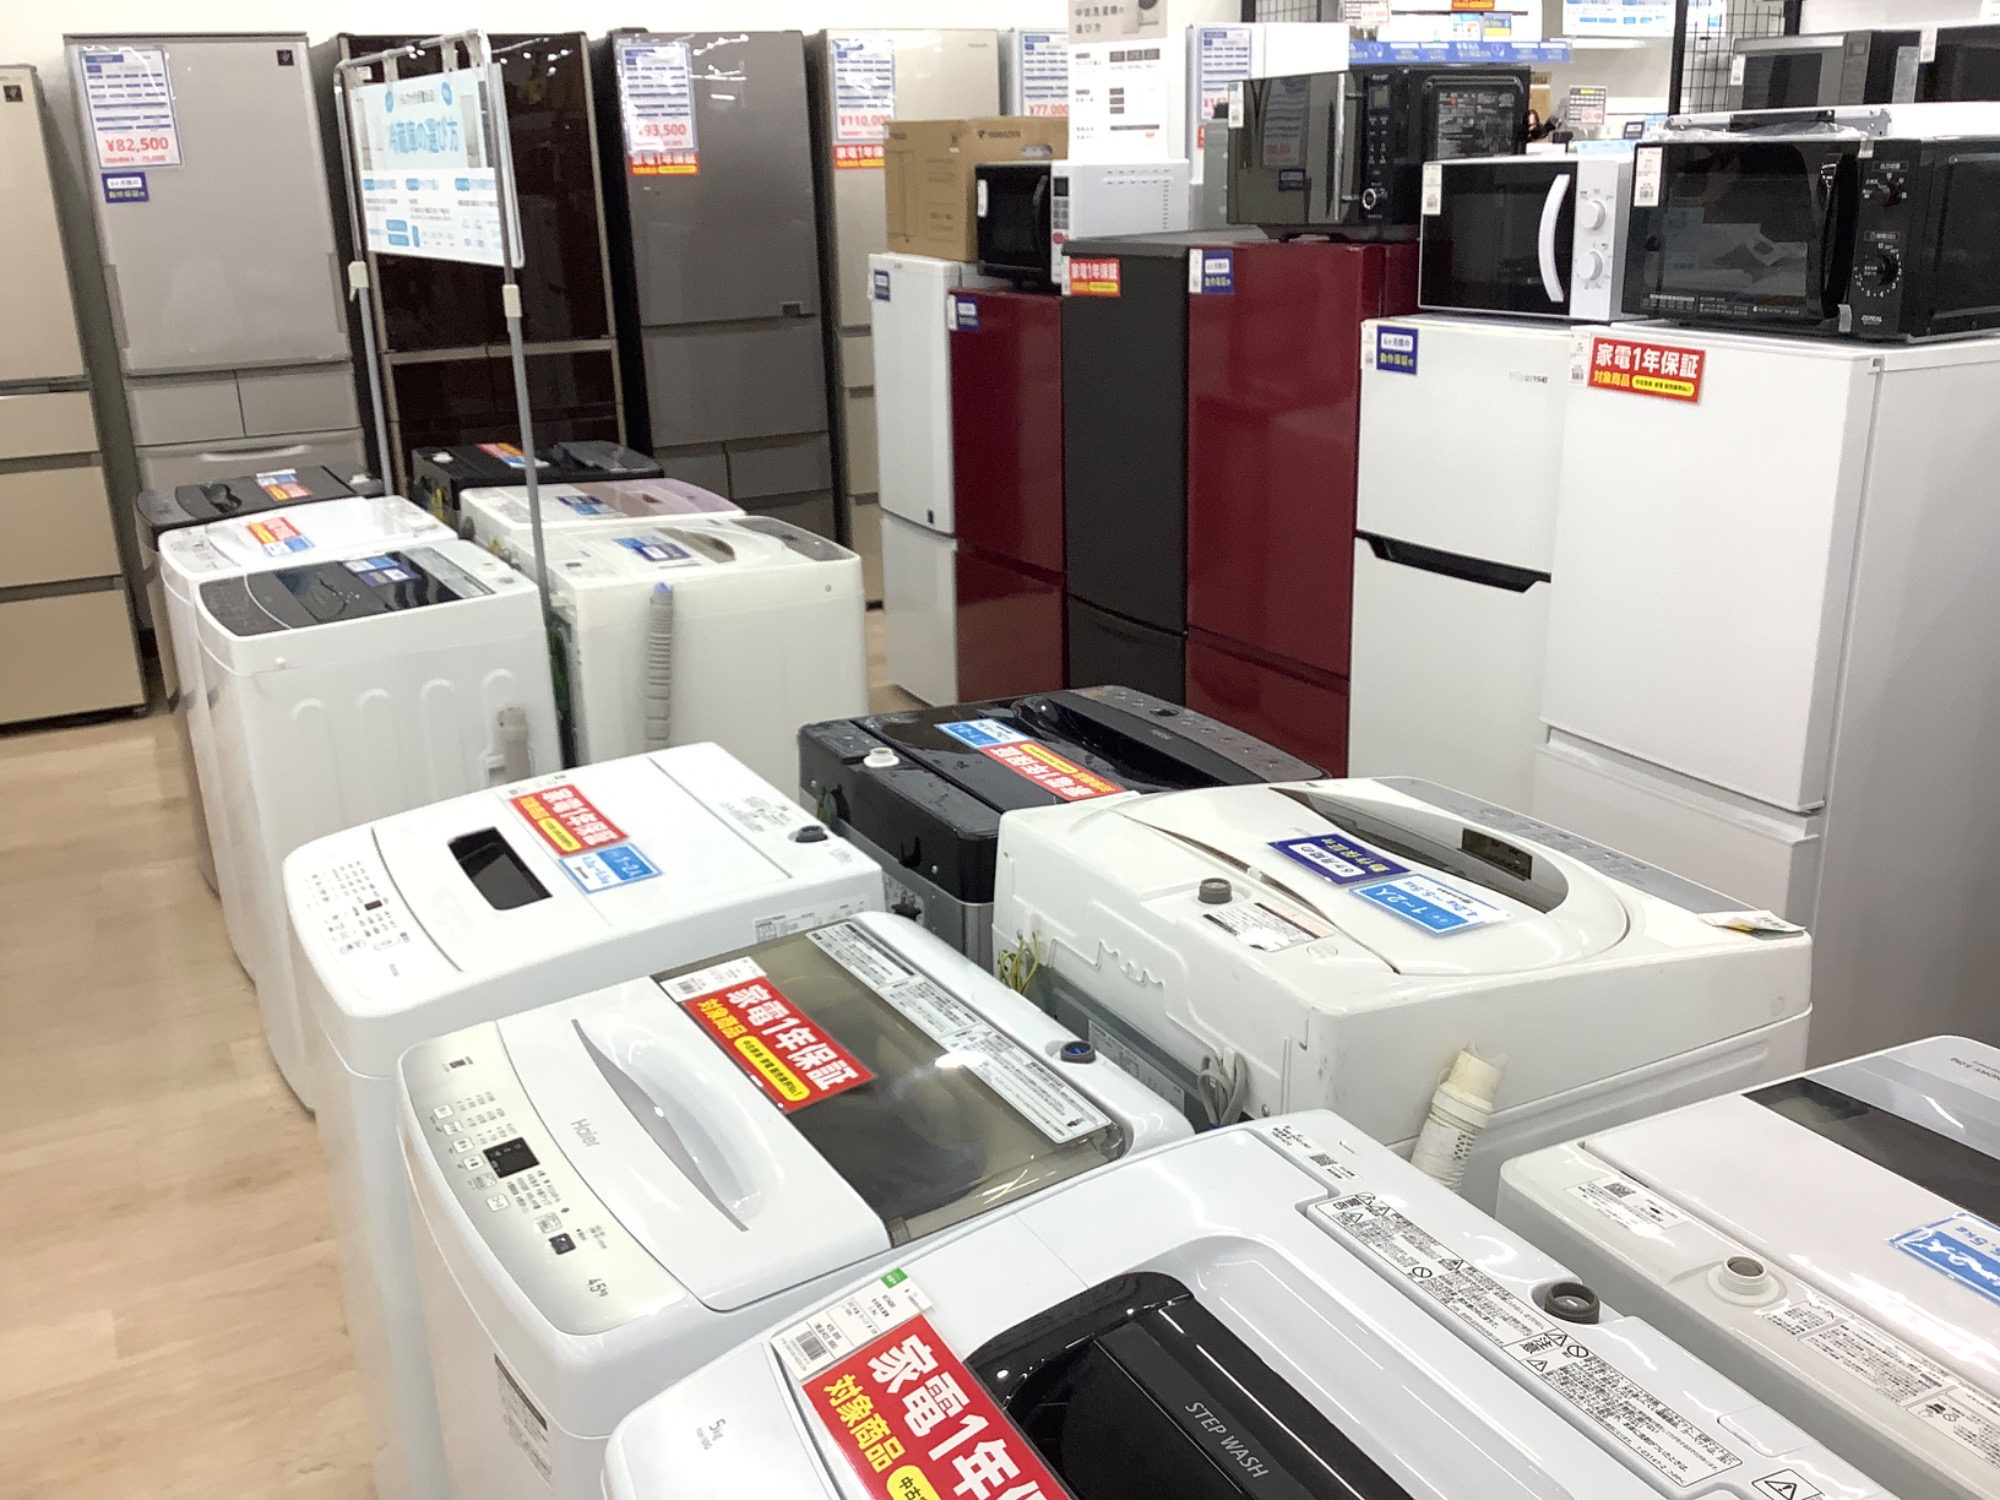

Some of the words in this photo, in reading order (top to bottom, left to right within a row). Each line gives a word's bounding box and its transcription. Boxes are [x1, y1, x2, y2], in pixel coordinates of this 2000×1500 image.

[105, 136, 169, 152] ¥82,500
[1597, 343, 1699, 379] 家電1年保証
[1594, 370, 1631, 387] 対象商品
[697, 998, 748, 1039] 対象商品
[726, 984, 859, 1091] 家電1年保証
[570, 1118, 600, 1148] Haier
[1519, 1336, 1554, 1355] 注意
[708, 1418, 726, 1441] 5kg
[823, 1374, 906, 1473] 対象商品
[1185, 1402, 1227, 1433] STEP
[1221, 1435, 1269, 1478] WASH
